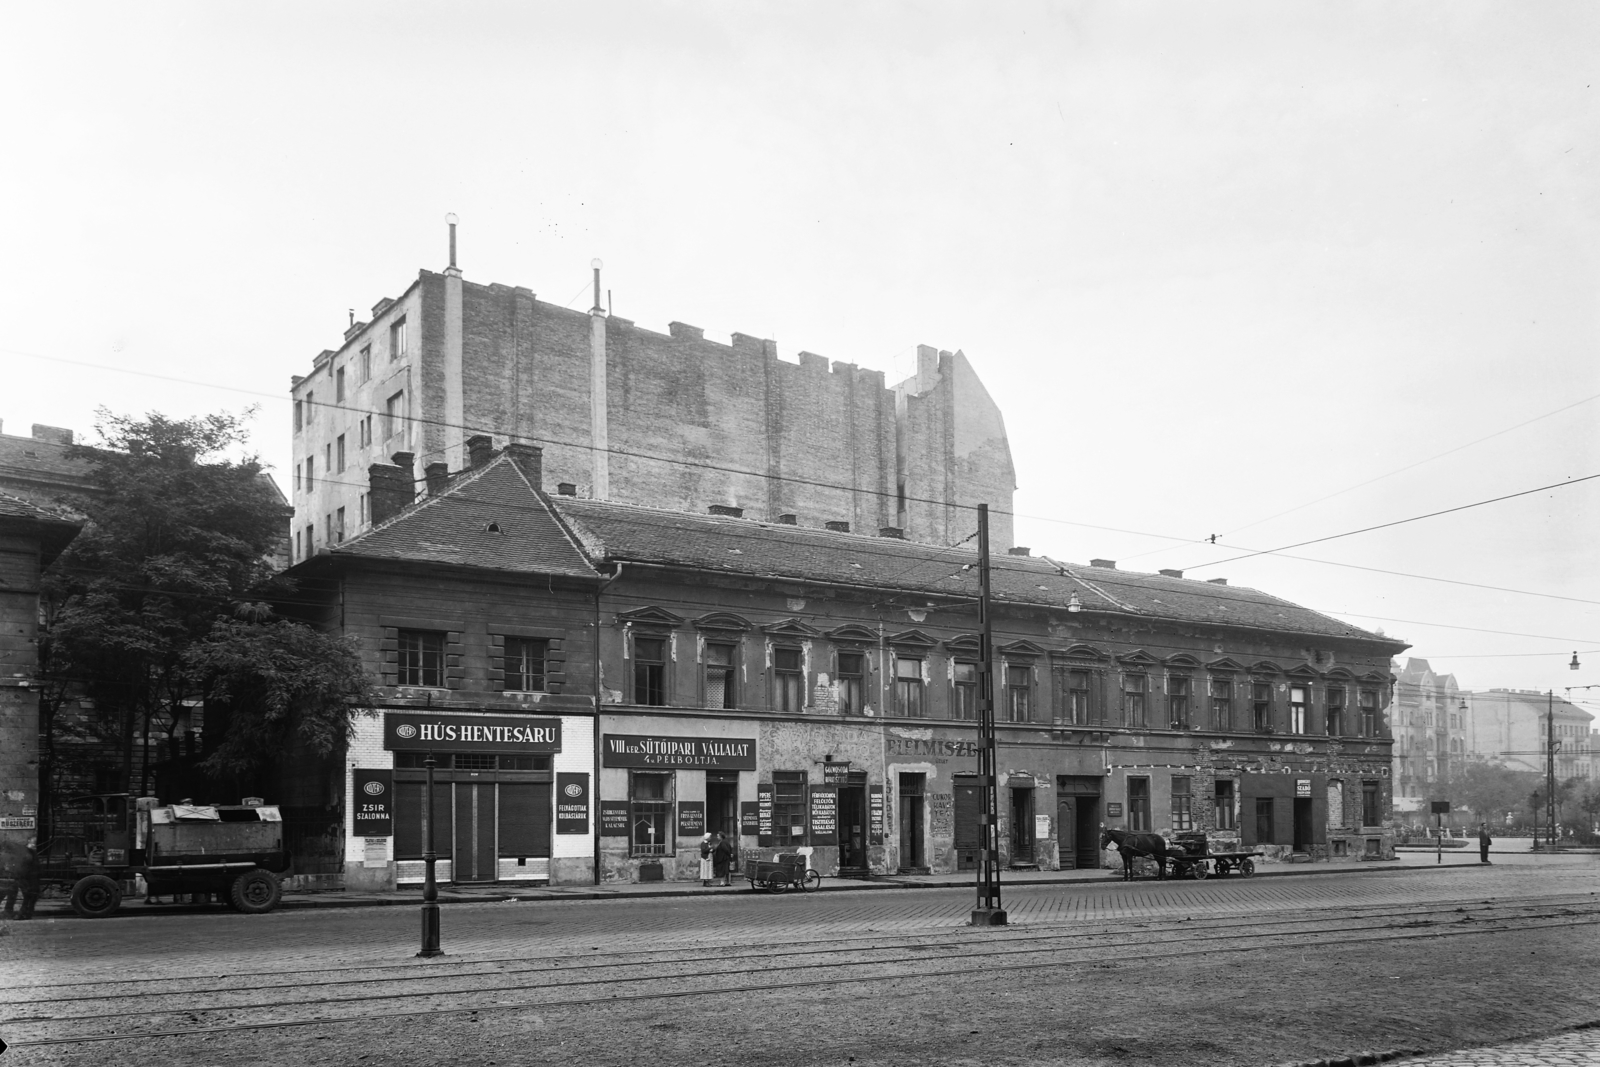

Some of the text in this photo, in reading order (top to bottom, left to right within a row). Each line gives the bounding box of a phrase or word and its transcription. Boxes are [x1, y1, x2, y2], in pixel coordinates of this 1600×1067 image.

[420, 722, 556, 743] HÚS-HENTESÁRU
[610, 740, 625, 753] VIII
[640, 738, 695, 755] SÜTŐIPARI
[702, 740, 749, 757] VÁLLALAT
[363, 804, 385, 812] ZSIR
